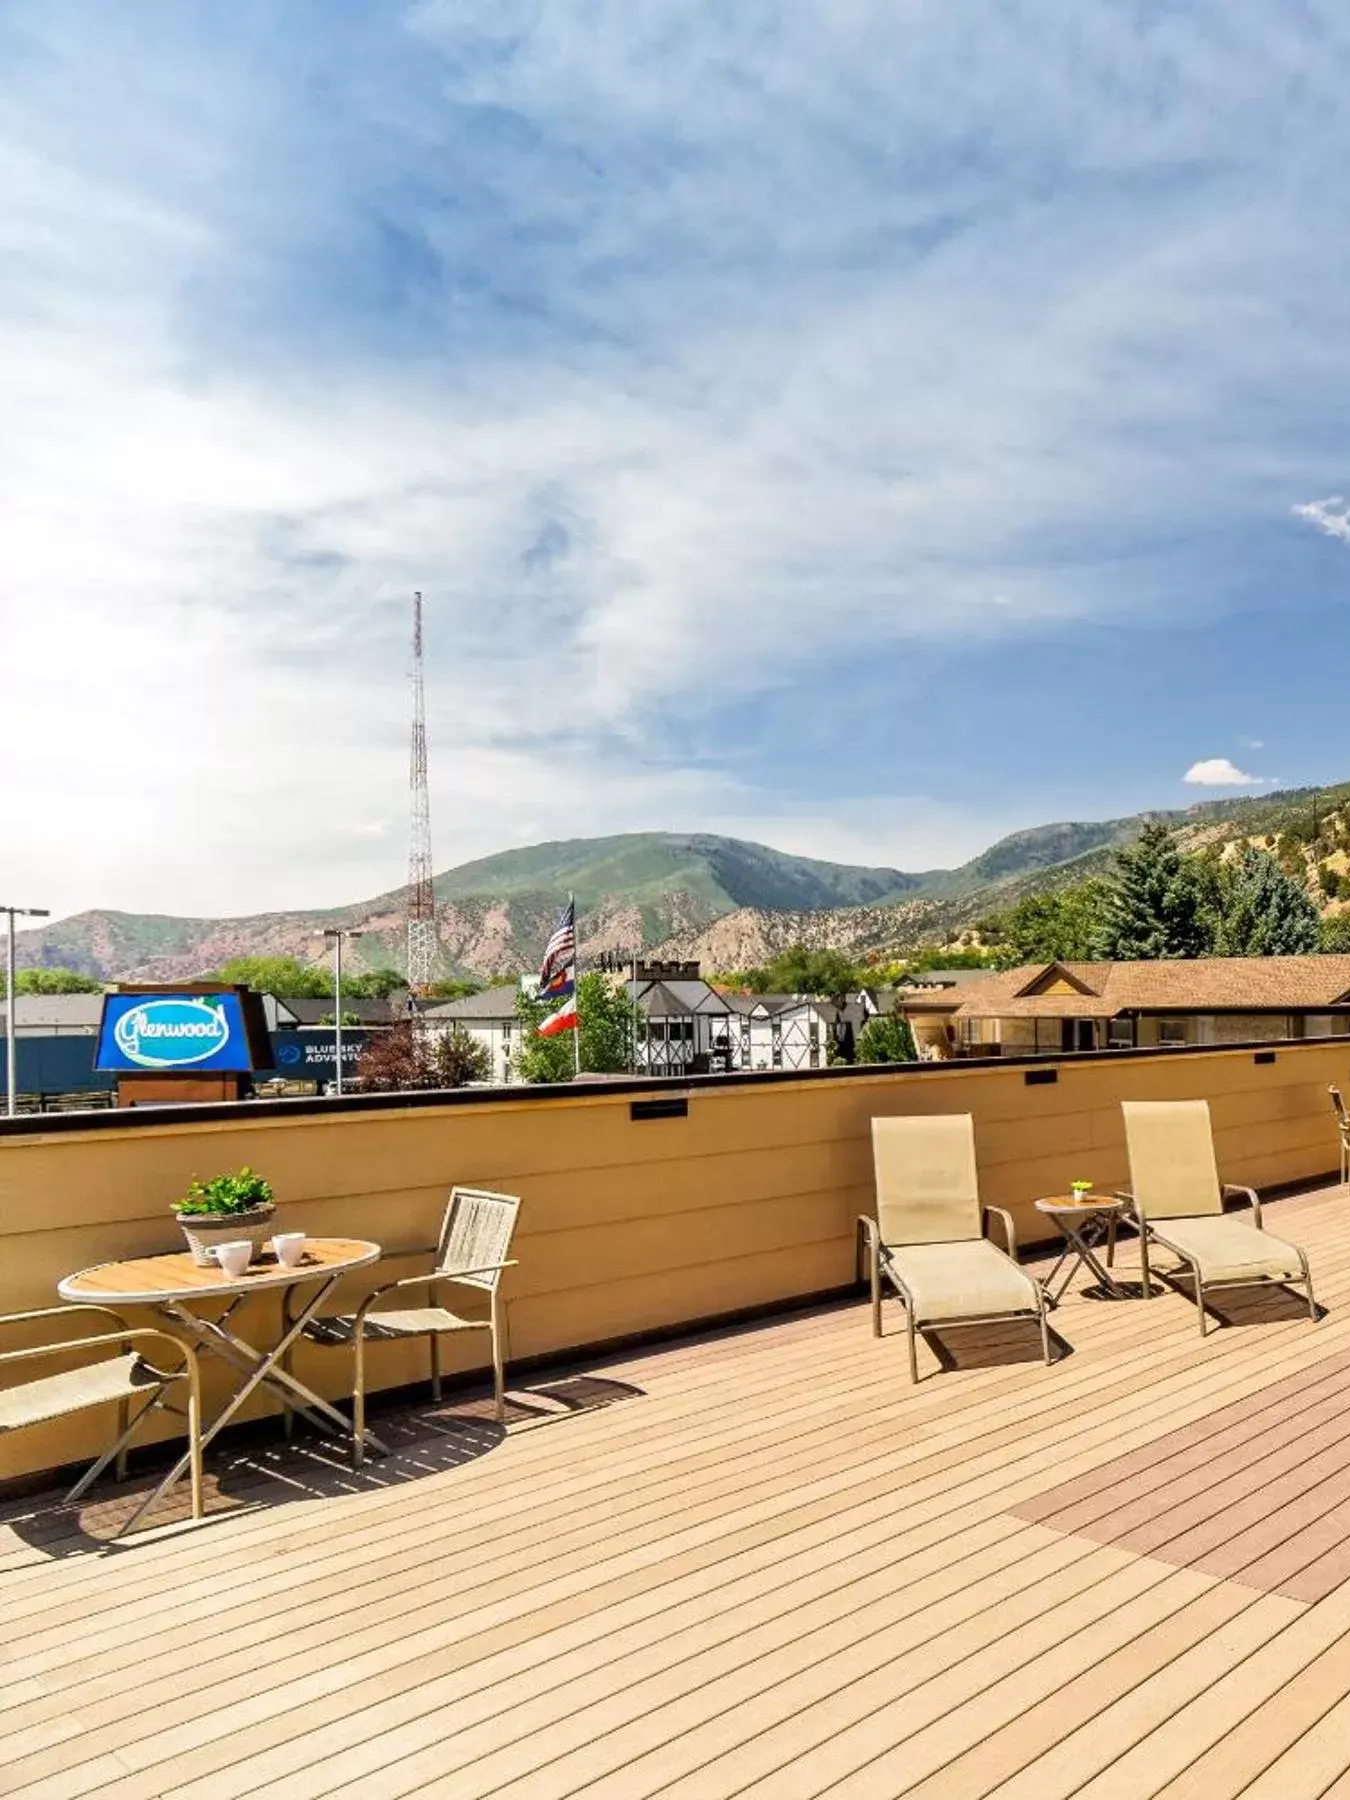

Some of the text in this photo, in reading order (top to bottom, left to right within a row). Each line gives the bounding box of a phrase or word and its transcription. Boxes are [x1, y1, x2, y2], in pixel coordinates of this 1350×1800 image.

[120, 1005, 224, 1054] Glenwood
[305, 1044, 362, 1054] BLUE SKY
[305, 1053, 366, 1063] ADVENTU
